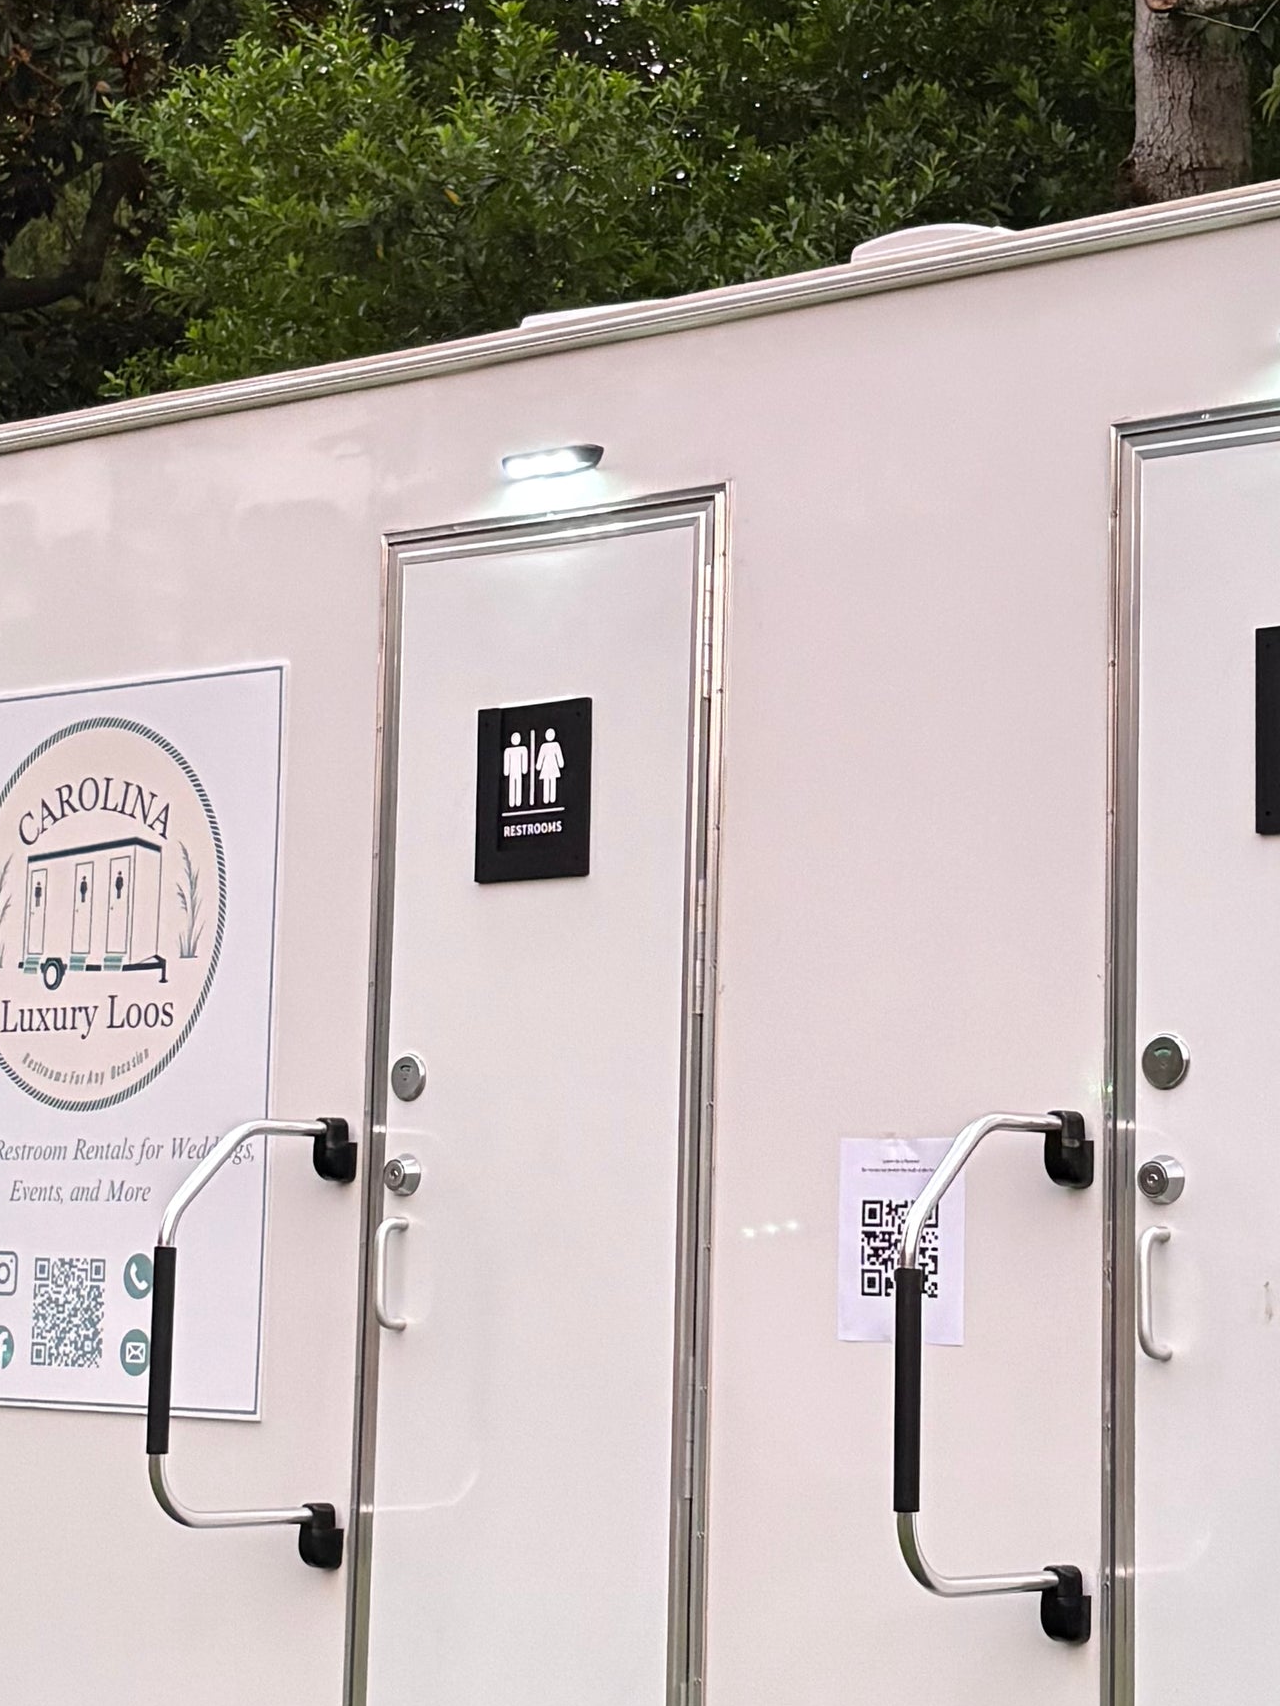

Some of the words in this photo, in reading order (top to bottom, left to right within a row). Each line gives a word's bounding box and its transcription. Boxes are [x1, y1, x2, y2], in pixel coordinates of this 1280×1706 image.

[18, 776, 170, 845] CAROLINA
[503, 820, 562, 837] RESTROOMS
[0, 999, 99, 1040] Luxury
[106, 994, 174, 1029] Loos
[21, 1052, 68, 1084] Restrooms
[69, 1070, 85, 1085] For
[86, 1069, 105, 1086] Any
[110, 1047, 149, 1080] Occasion
[72, 1137, 135, 1161] Rentals
[135, 1137, 164, 1166] for
[171, 1135, 255, 1166] Weddgs,
[9, 1179, 64, 1204] Events,
[69, 1178, 102, 1202] and
[105, 1180, 152, 1202] More
